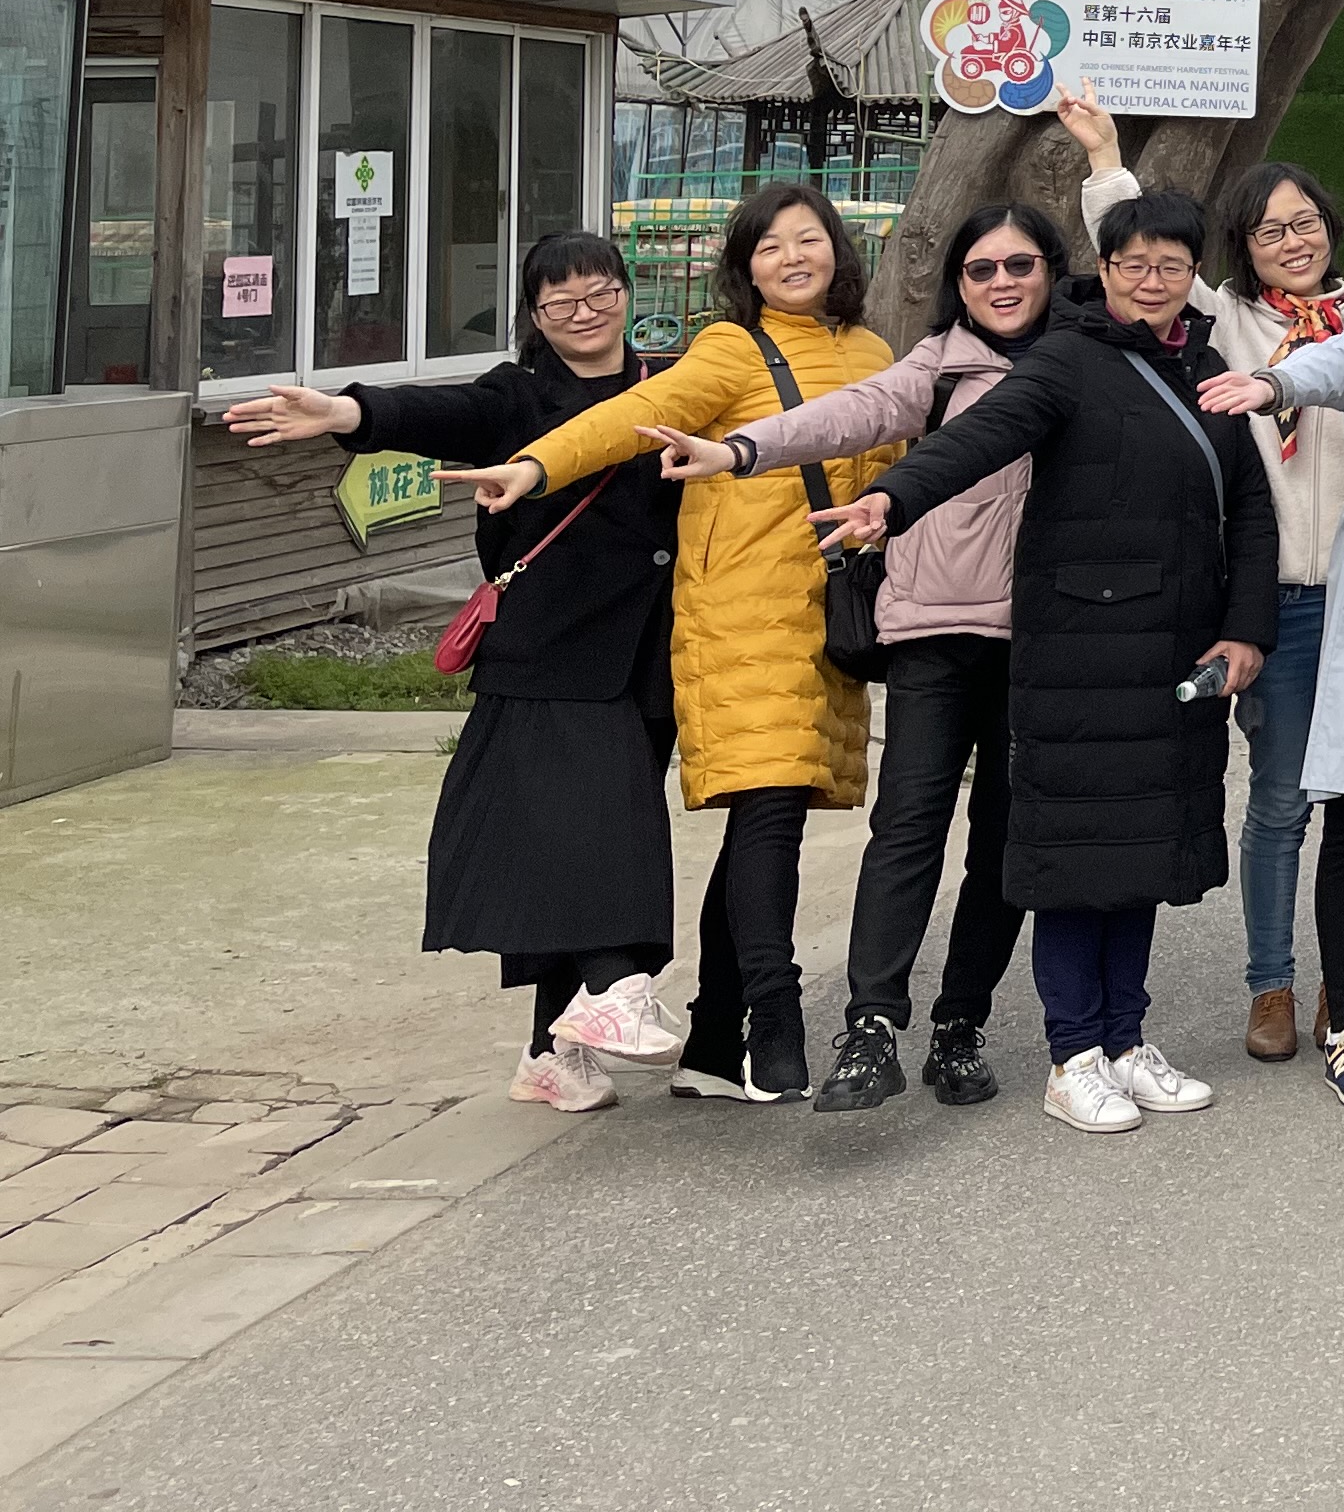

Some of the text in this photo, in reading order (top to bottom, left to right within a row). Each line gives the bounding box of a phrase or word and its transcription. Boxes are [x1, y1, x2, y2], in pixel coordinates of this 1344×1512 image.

[1083, 4, 1171, 24] 暨第十六届
[1079, 62, 1100, 71] 2020
[1101, 63, 1135, 72] CHINESE
[1176, 66, 1212, 74] HARVEST
[1213, 67, 1250, 76] FESTIVAL
[1108, 77, 1140, 89] 16TH
[1144, 78, 1187, 90] CHINA
[1189, 80, 1250, 93] NANJING
[1080, 94, 1248, 111] RICULTURAL CARNIVAL
[368, 459, 436, 507] 桃花源
